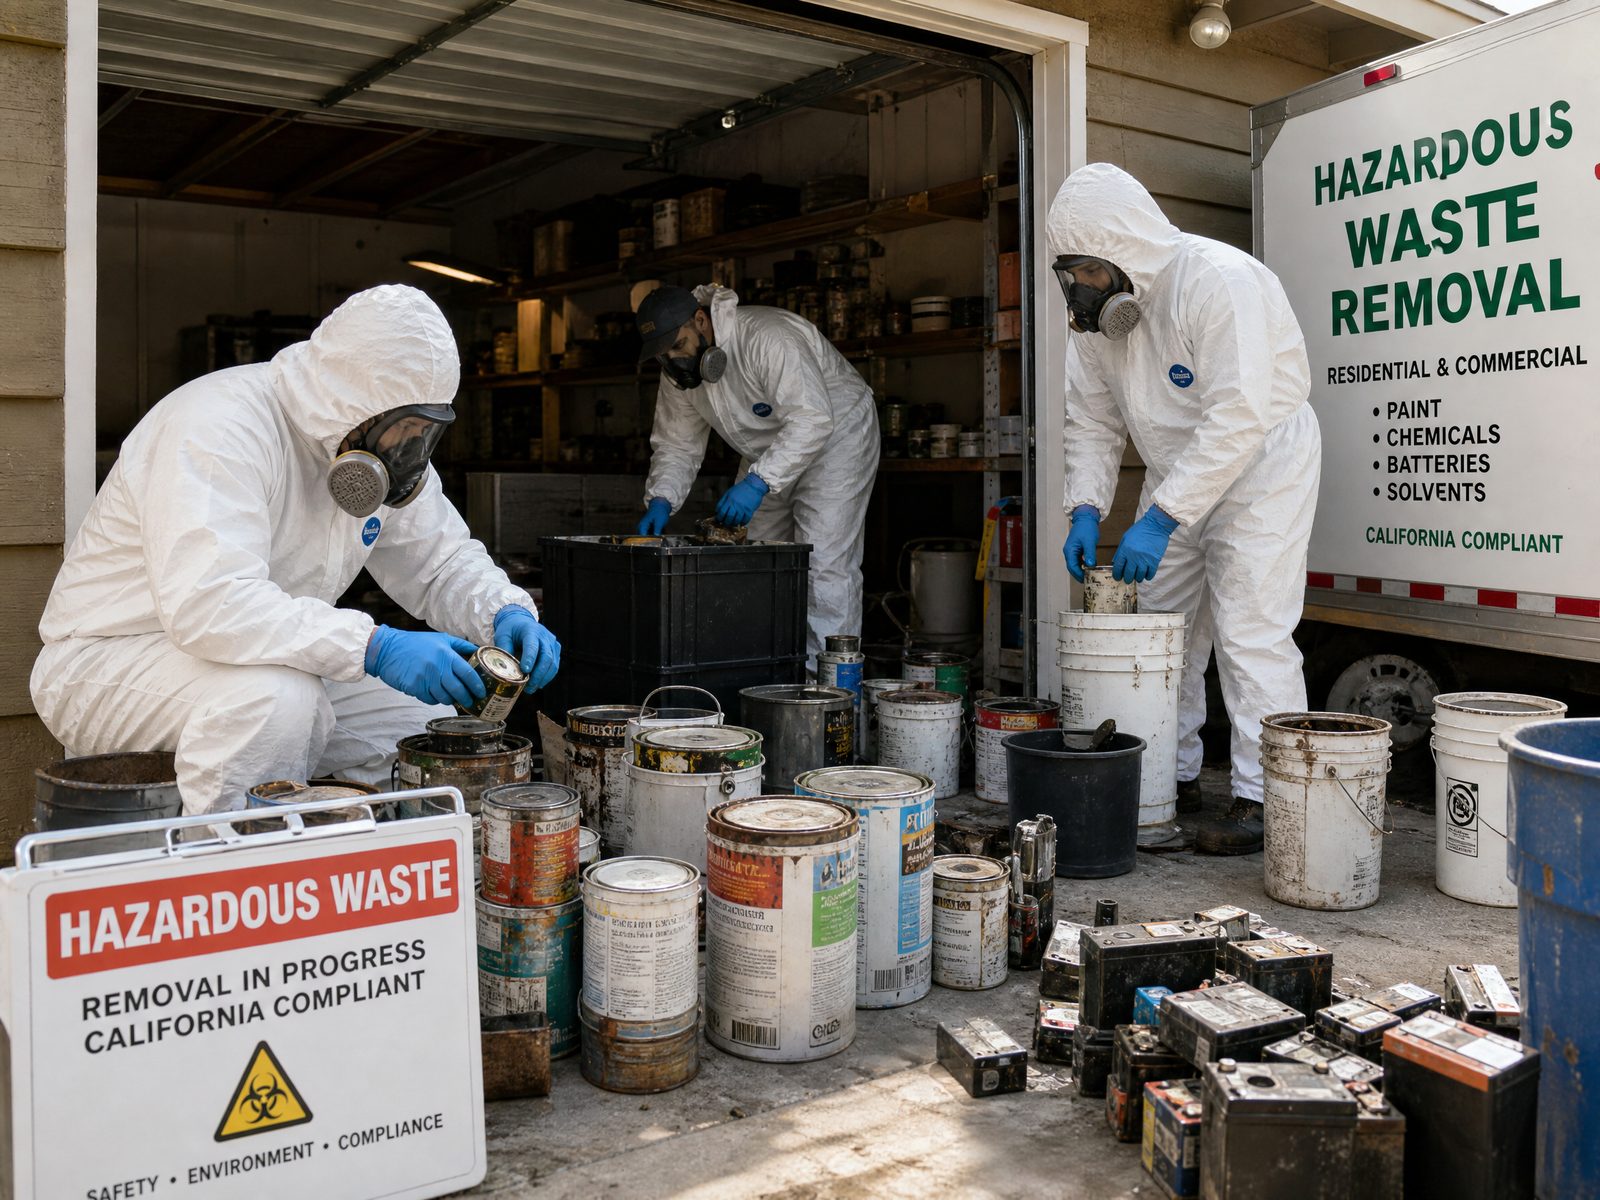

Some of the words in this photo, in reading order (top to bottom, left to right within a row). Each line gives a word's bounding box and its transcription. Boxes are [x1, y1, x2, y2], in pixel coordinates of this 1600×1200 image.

[1315, 100, 1573, 206] HAZARDOUS
[1345, 181, 1539, 268] WASTE
[1332, 258, 1580, 336] REMOVAL
[1327, 360, 1431, 385] RESIDENTIAL
[1436, 357, 1449, 377] &
[1455, 345, 1588, 376] COMMERCIAL
[1387, 399, 1442, 420] PAINT
[1387, 424, 1501, 446] CHEMICALS
[1387, 453, 1491, 473] BATTERIES
[1387, 482, 1486, 502] SOLVENTS
[1366, 526, 1456, 548] CALIFORNIA
[1461, 531, 1563, 554] COMPLIANT
[59, 878, 320, 959] HAZARDOUS
[329, 858, 452, 914] WASTE
[82, 975, 231, 1021] REMOVAL
[243, 966, 271, 991] IN
[282, 939, 427, 984] PROGRESS
[84, 1001, 265, 1055] CALIFORNIA
[273, 969, 426, 1018] COMPLIANT
[86, 1176, 159, 1200] SAFETY
[188, 1141, 315, 1184] ENVIRONMENT
[338, 1113, 444, 1150] COMPLIANCE
